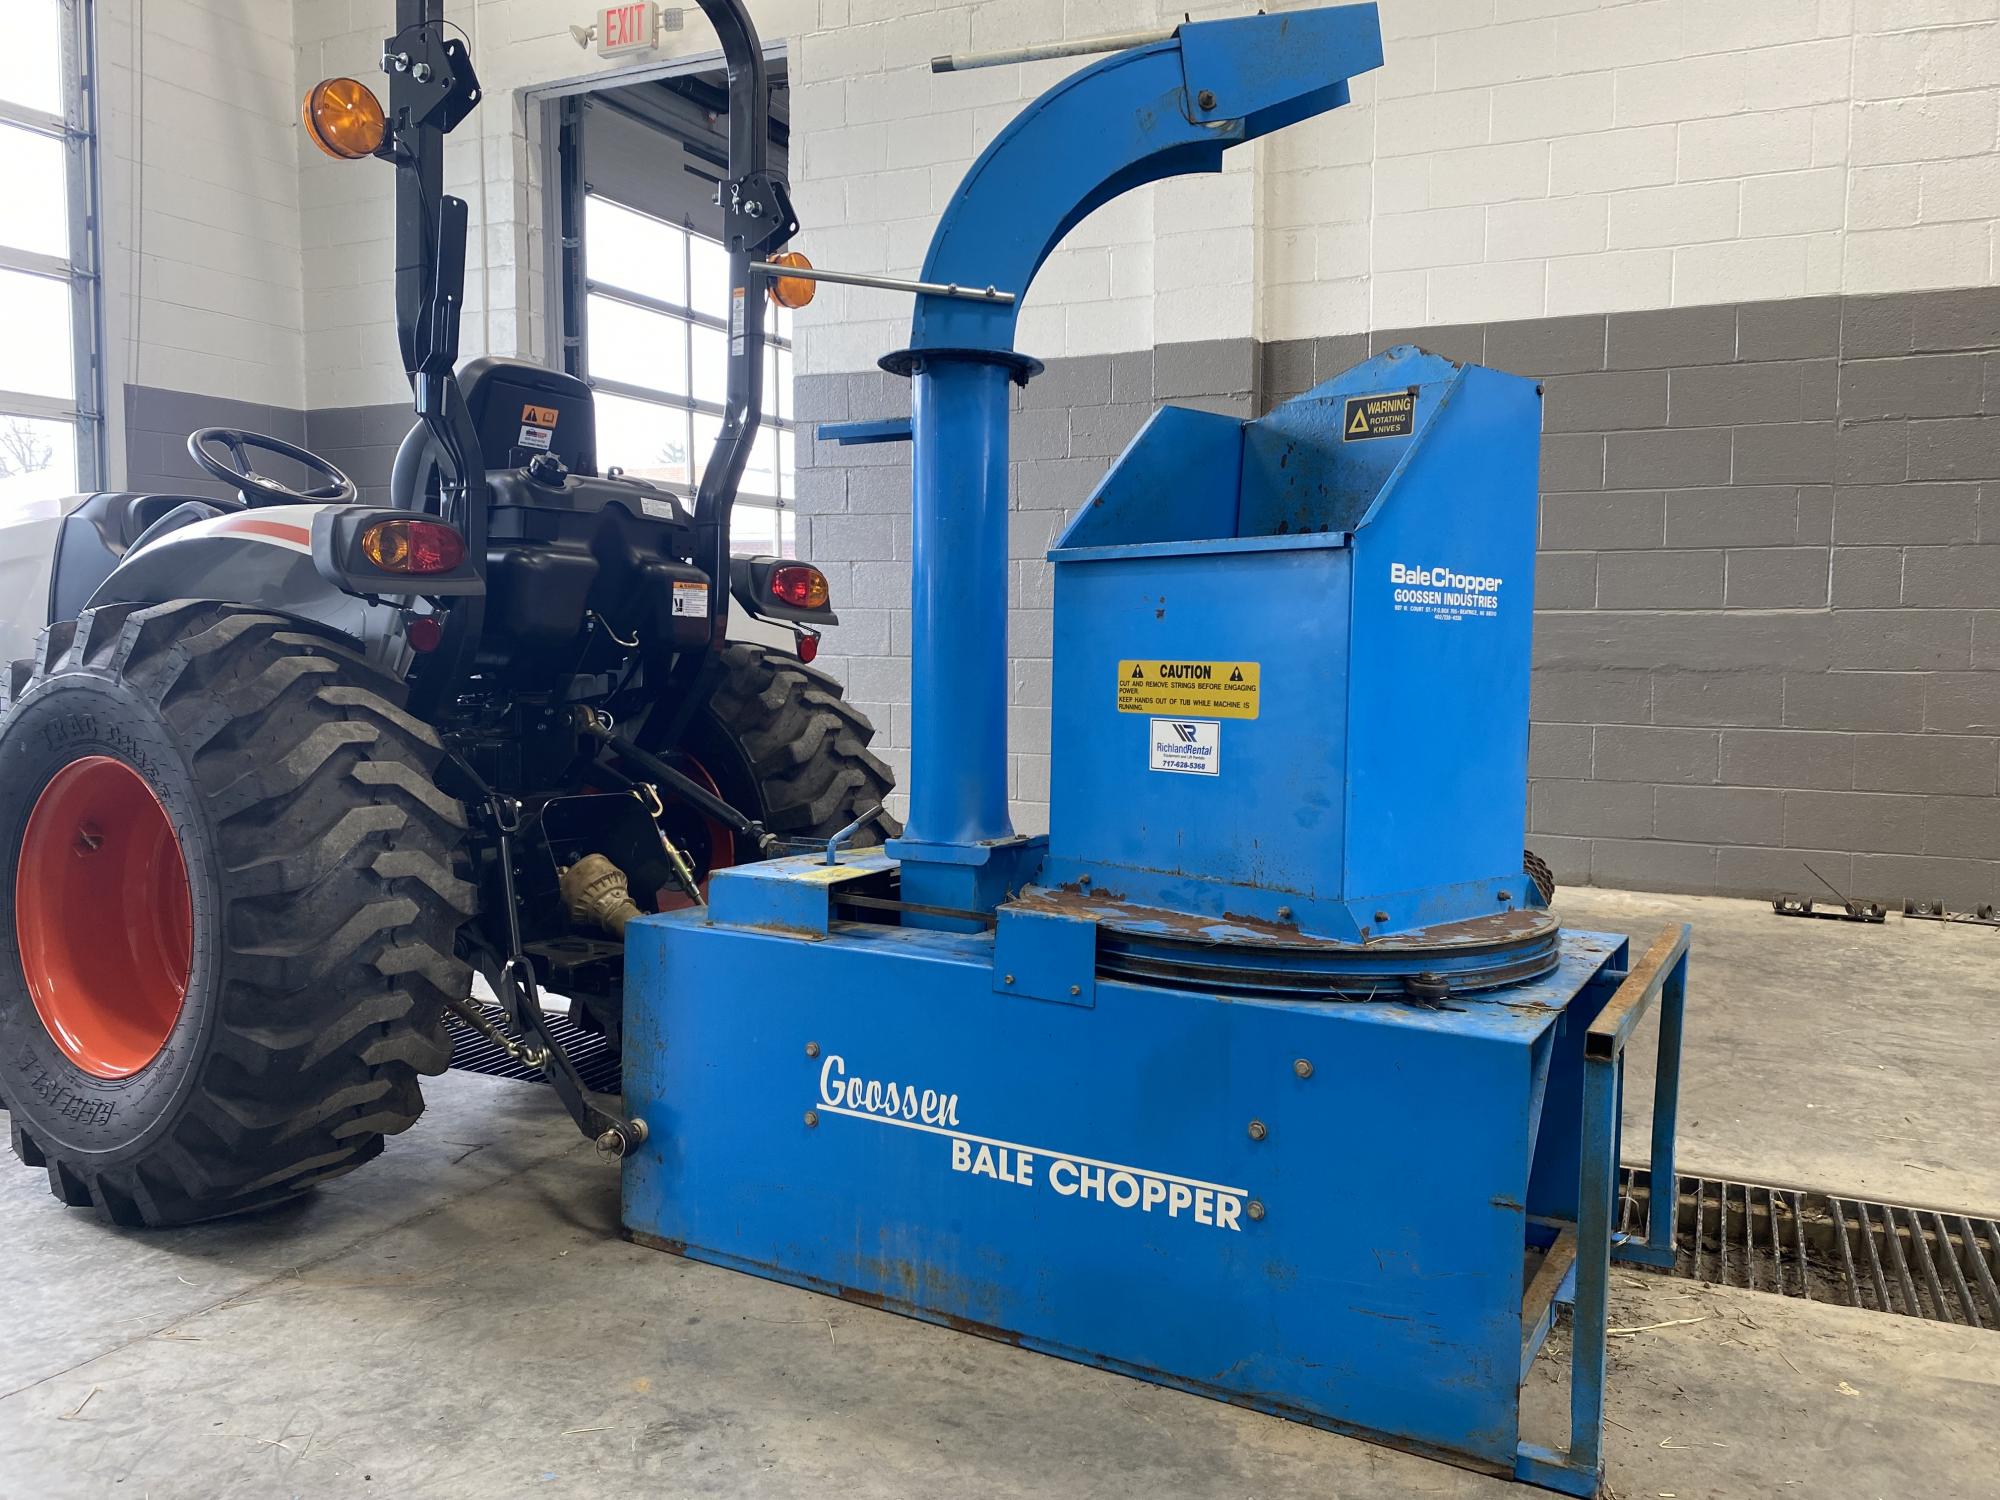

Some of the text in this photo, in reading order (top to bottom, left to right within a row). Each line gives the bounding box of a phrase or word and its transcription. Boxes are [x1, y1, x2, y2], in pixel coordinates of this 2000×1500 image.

[607, 4, 645, 47] EXIT
[1367, 398, 1411, 415] WARNING
[1370, 414, 1406, 425] ROTATING
[1373, 424, 1401, 434] KNIVES
[1394, 589, 1498, 609] GOOSSEN INDUSTRIES
[1160, 664, 1212, 679] CAUTION
[1145, 681, 1168, 689] REMOVE
[1170, 681, 1196, 690] STRINGS
[1198, 682, 1222, 690] BEFORE
[1224, 683, 1257, 692] ENGAGING
[1193, 699, 1211, 707] WHILE
[1213, 700, 1241, 708] MACHINE
[1156, 742, 1212, 755] RichlandRental
[1162, 760, 1206, 770] 717-628-5368
[820, 1055, 960, 1127] Goossen
[952, 1138, 1242, 1232] BALE CHOPPER
